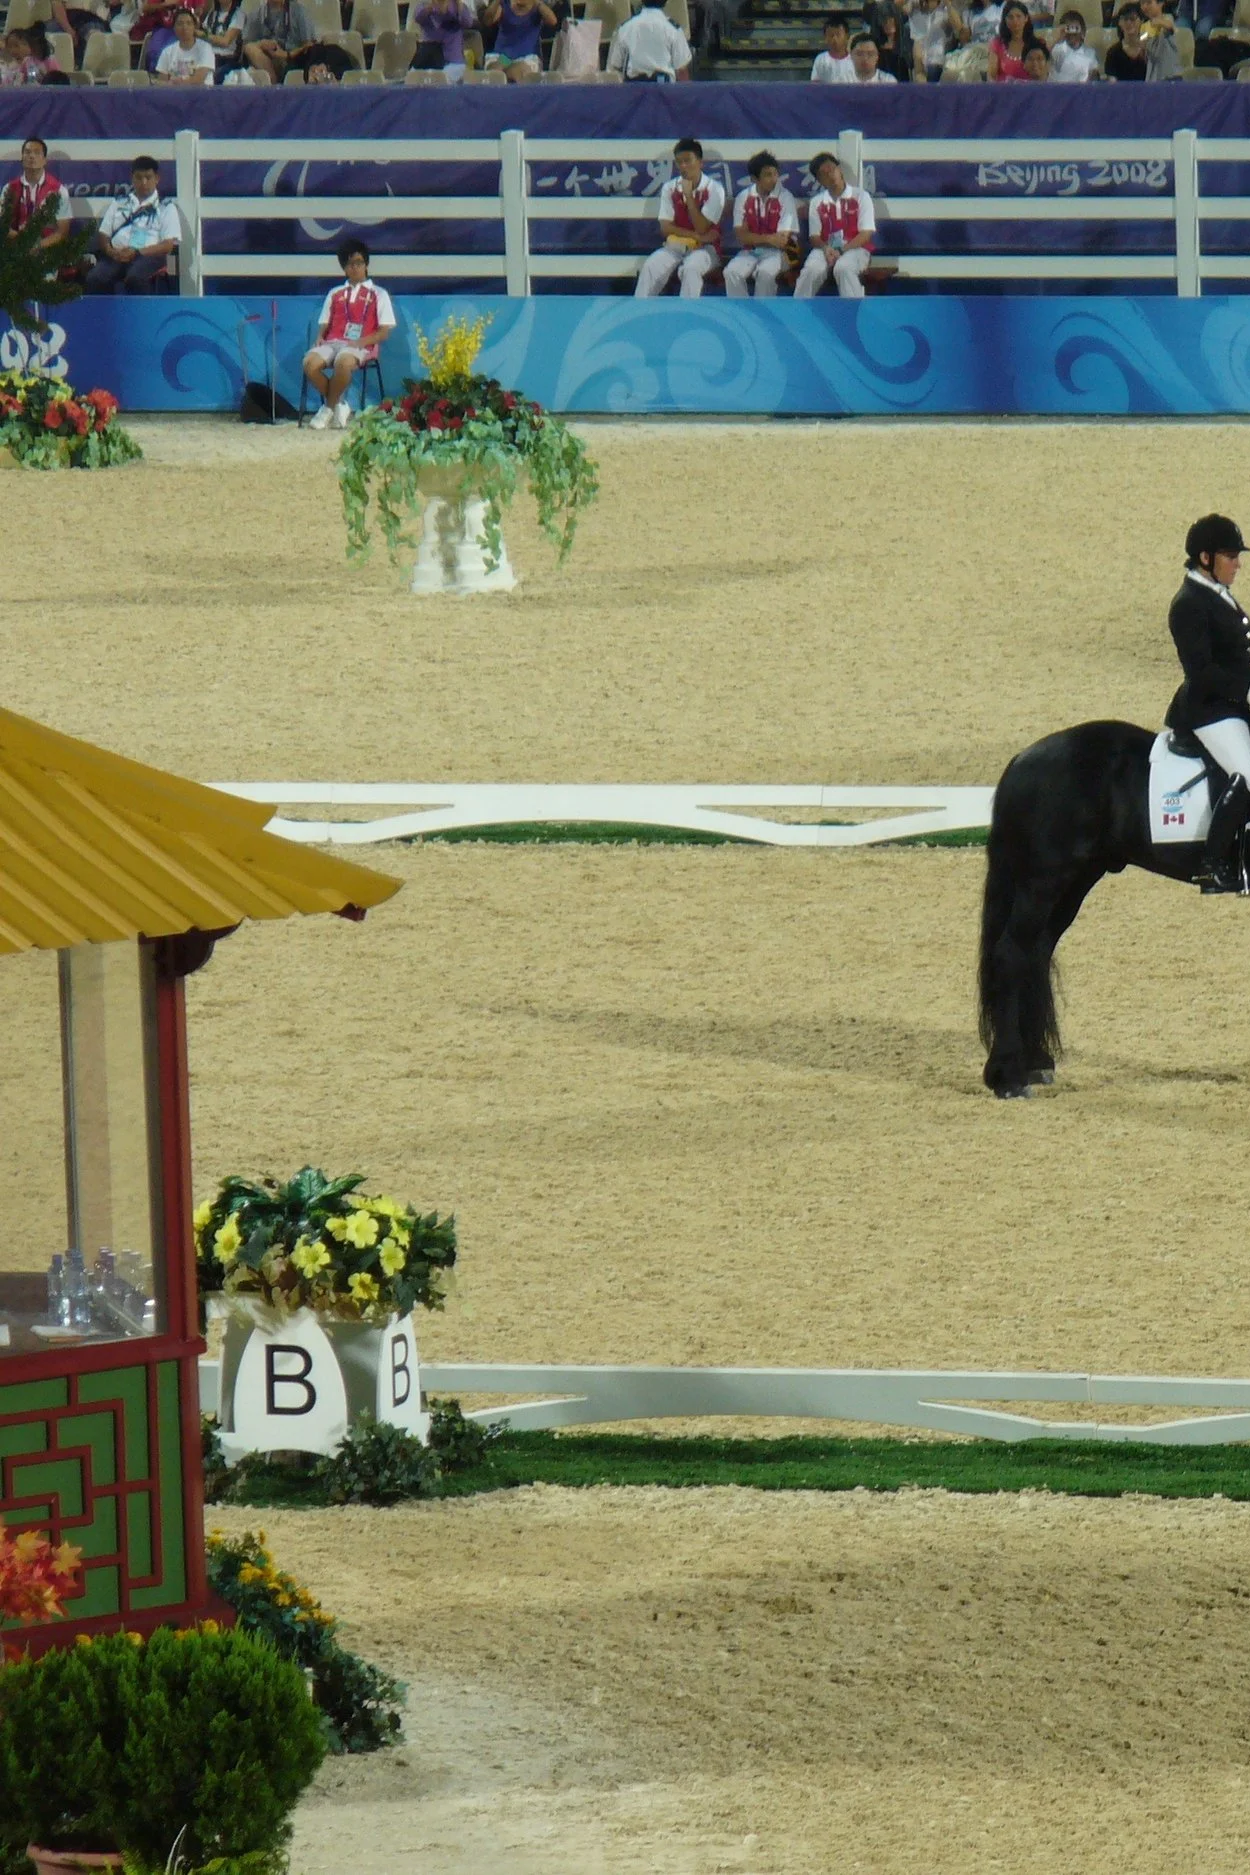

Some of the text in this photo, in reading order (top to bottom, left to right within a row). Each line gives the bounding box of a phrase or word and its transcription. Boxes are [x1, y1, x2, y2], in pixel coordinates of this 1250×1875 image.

[975, 160, 1168, 195] Beijing 2008
[265, 1343, 317, 1415] B
[391, 1333, 411, 1408] B
